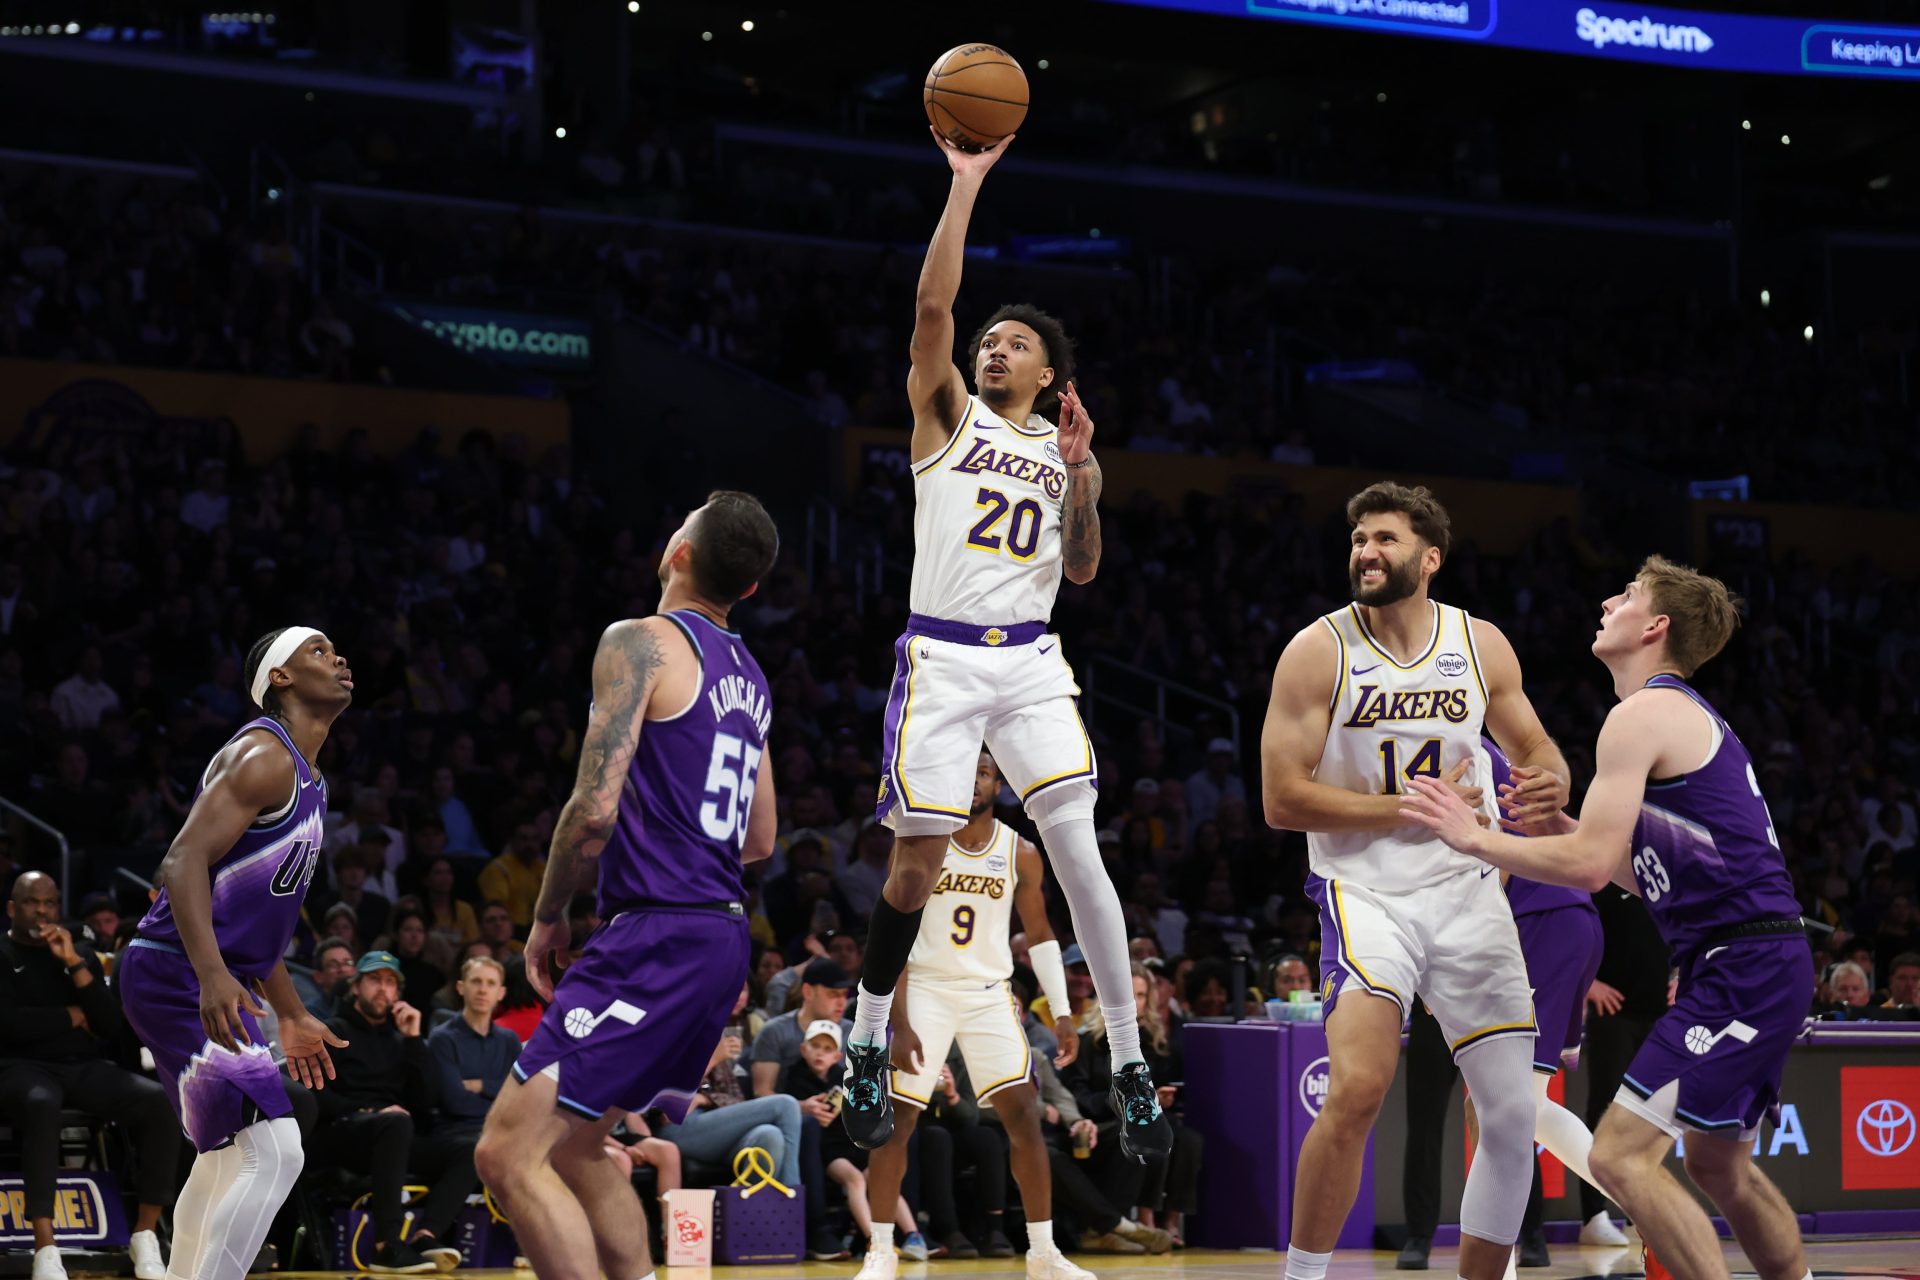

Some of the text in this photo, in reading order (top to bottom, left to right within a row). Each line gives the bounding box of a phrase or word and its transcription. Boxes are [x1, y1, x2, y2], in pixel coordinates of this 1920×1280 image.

[1576, 8, 1708, 52] Spectrum
[1832, 38, 1903, 66] Keeping
[951, 437, 1066, 500] LAKERS
[966, 487, 1043, 563] 20
[1438, 659, 1466, 670] bibigo
[708, 674, 772, 741] KONCHAR
[1343, 684, 1469, 728] LAKERS
[700, 731, 762, 850] 55
[1379, 737, 1443, 795] 14
[1633, 846, 1671, 903] 33
[950, 904, 976, 949] 9
